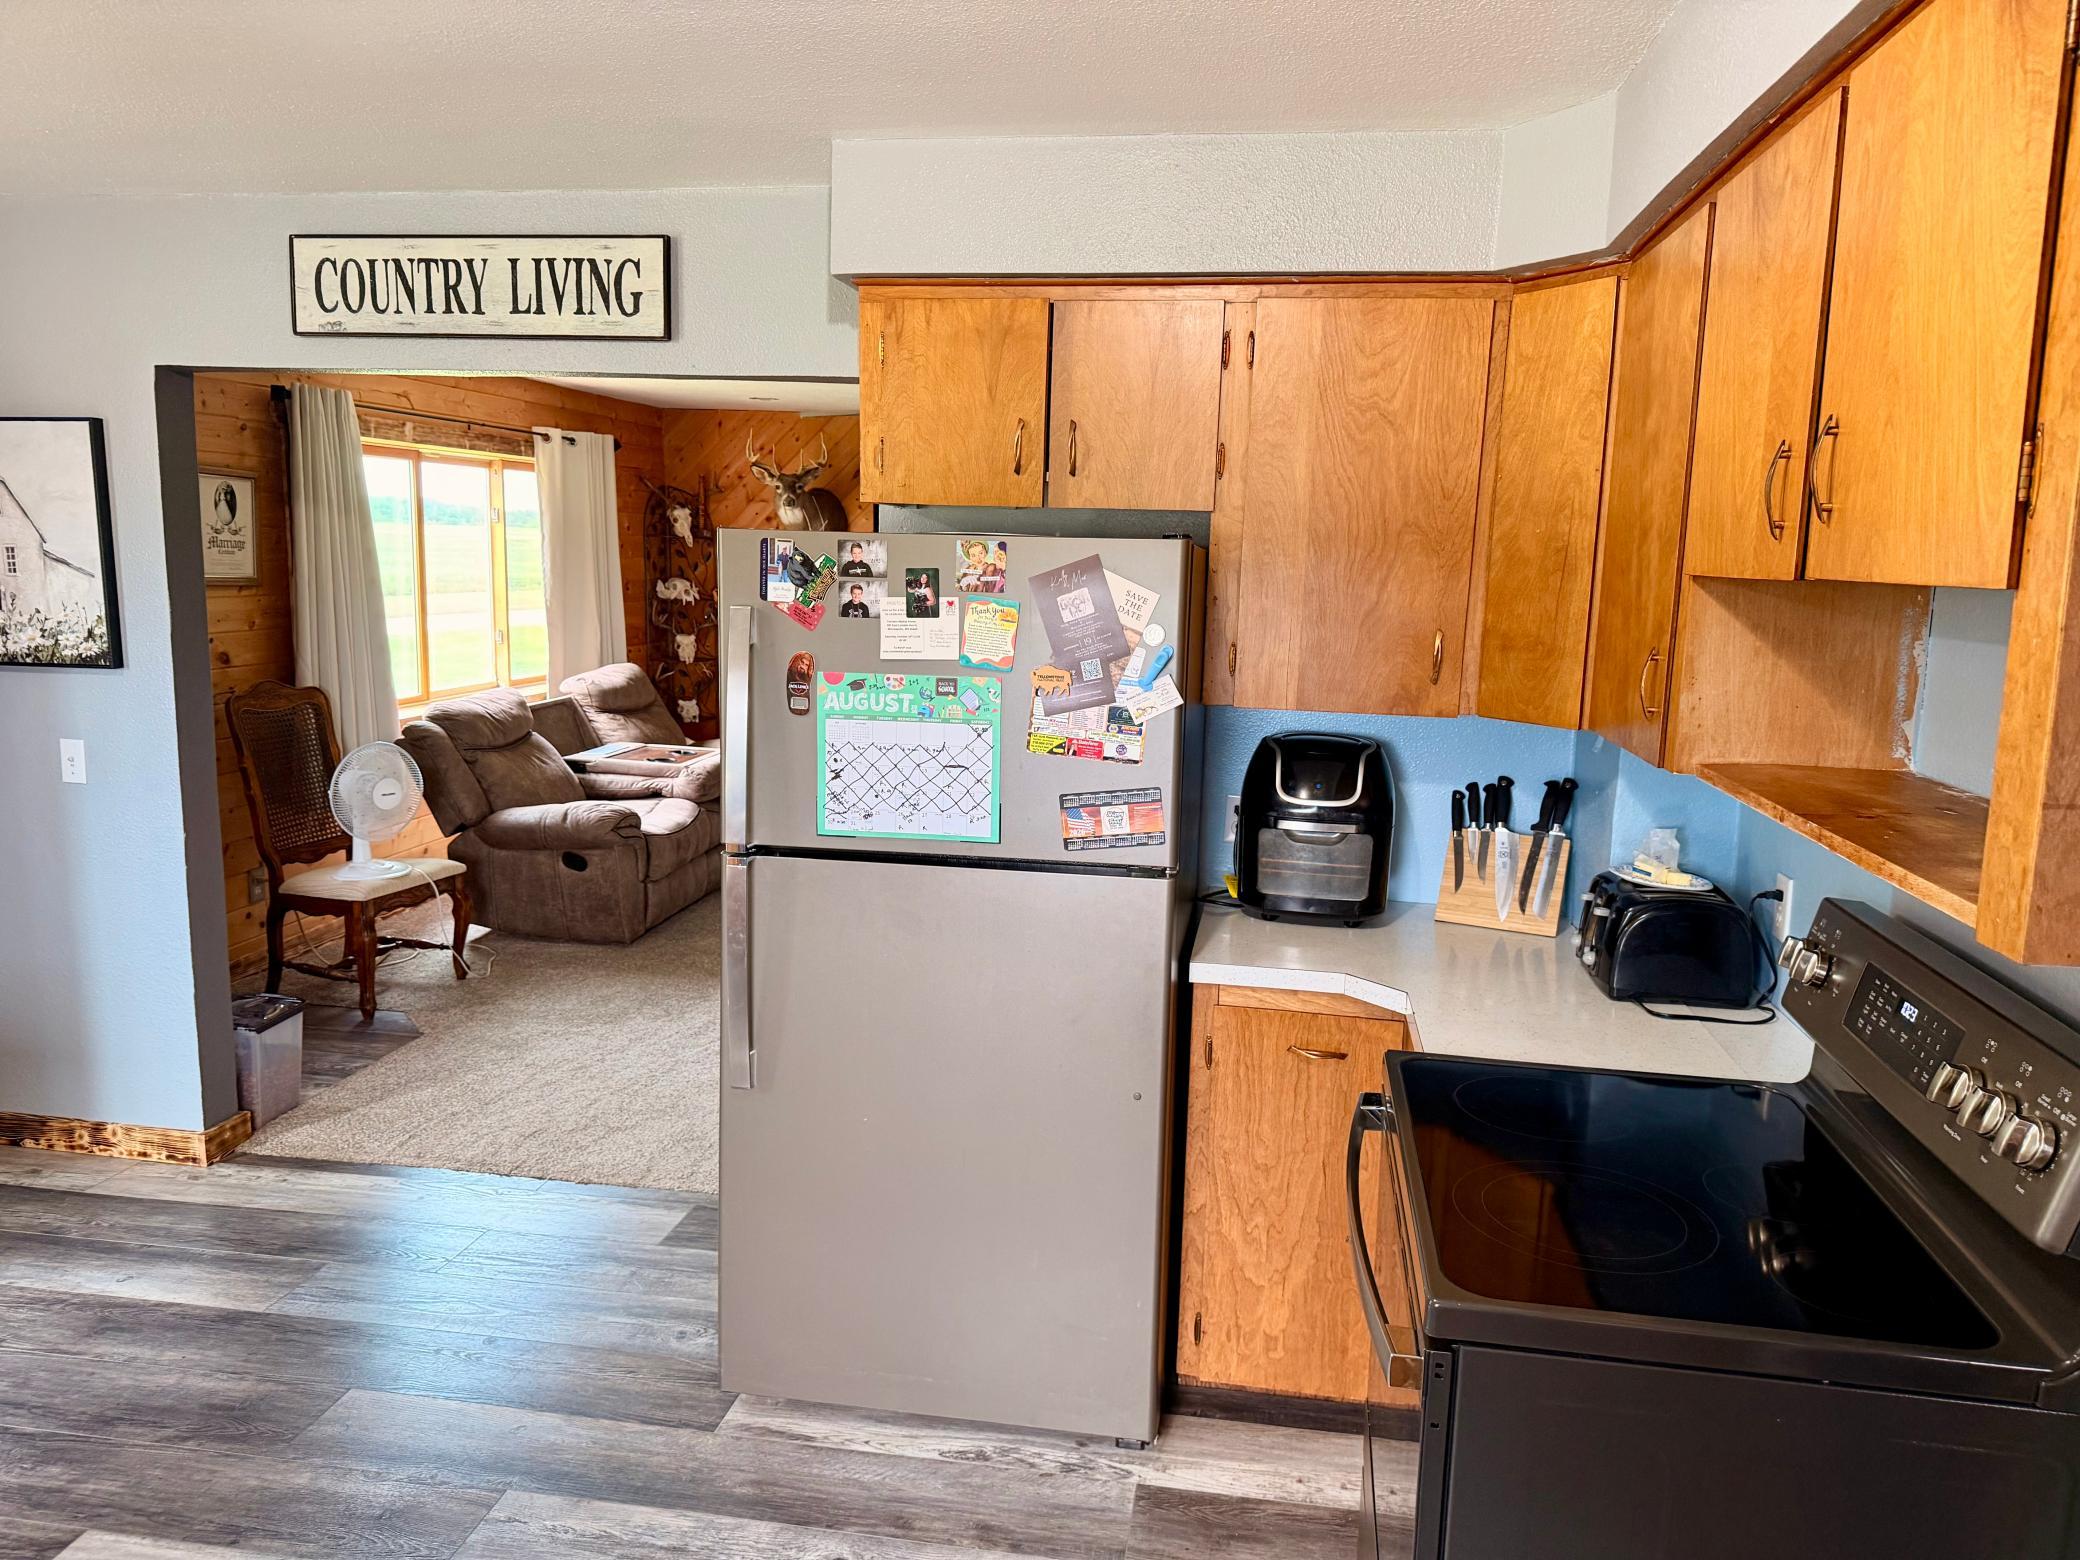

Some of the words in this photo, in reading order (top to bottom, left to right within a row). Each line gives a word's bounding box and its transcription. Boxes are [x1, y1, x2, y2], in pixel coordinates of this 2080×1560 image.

[313, 256, 488, 315] COUNTRY
[506, 256, 644, 318] LIVING
[206, 535, 246, 552] Marriage
[1124, 598, 1143, 612] THE
[1125, 589, 1150, 606] SAVE
[970, 605, 992, 616] Thank
[1118, 604, 1143, 622] DATE
[824, 691, 914, 713] AUGUST
[2015, 1080, 2023, 1088] Off
[2053, 1107, 2061, 1116] Off
[2015, 1184, 2025, 1195] Front
